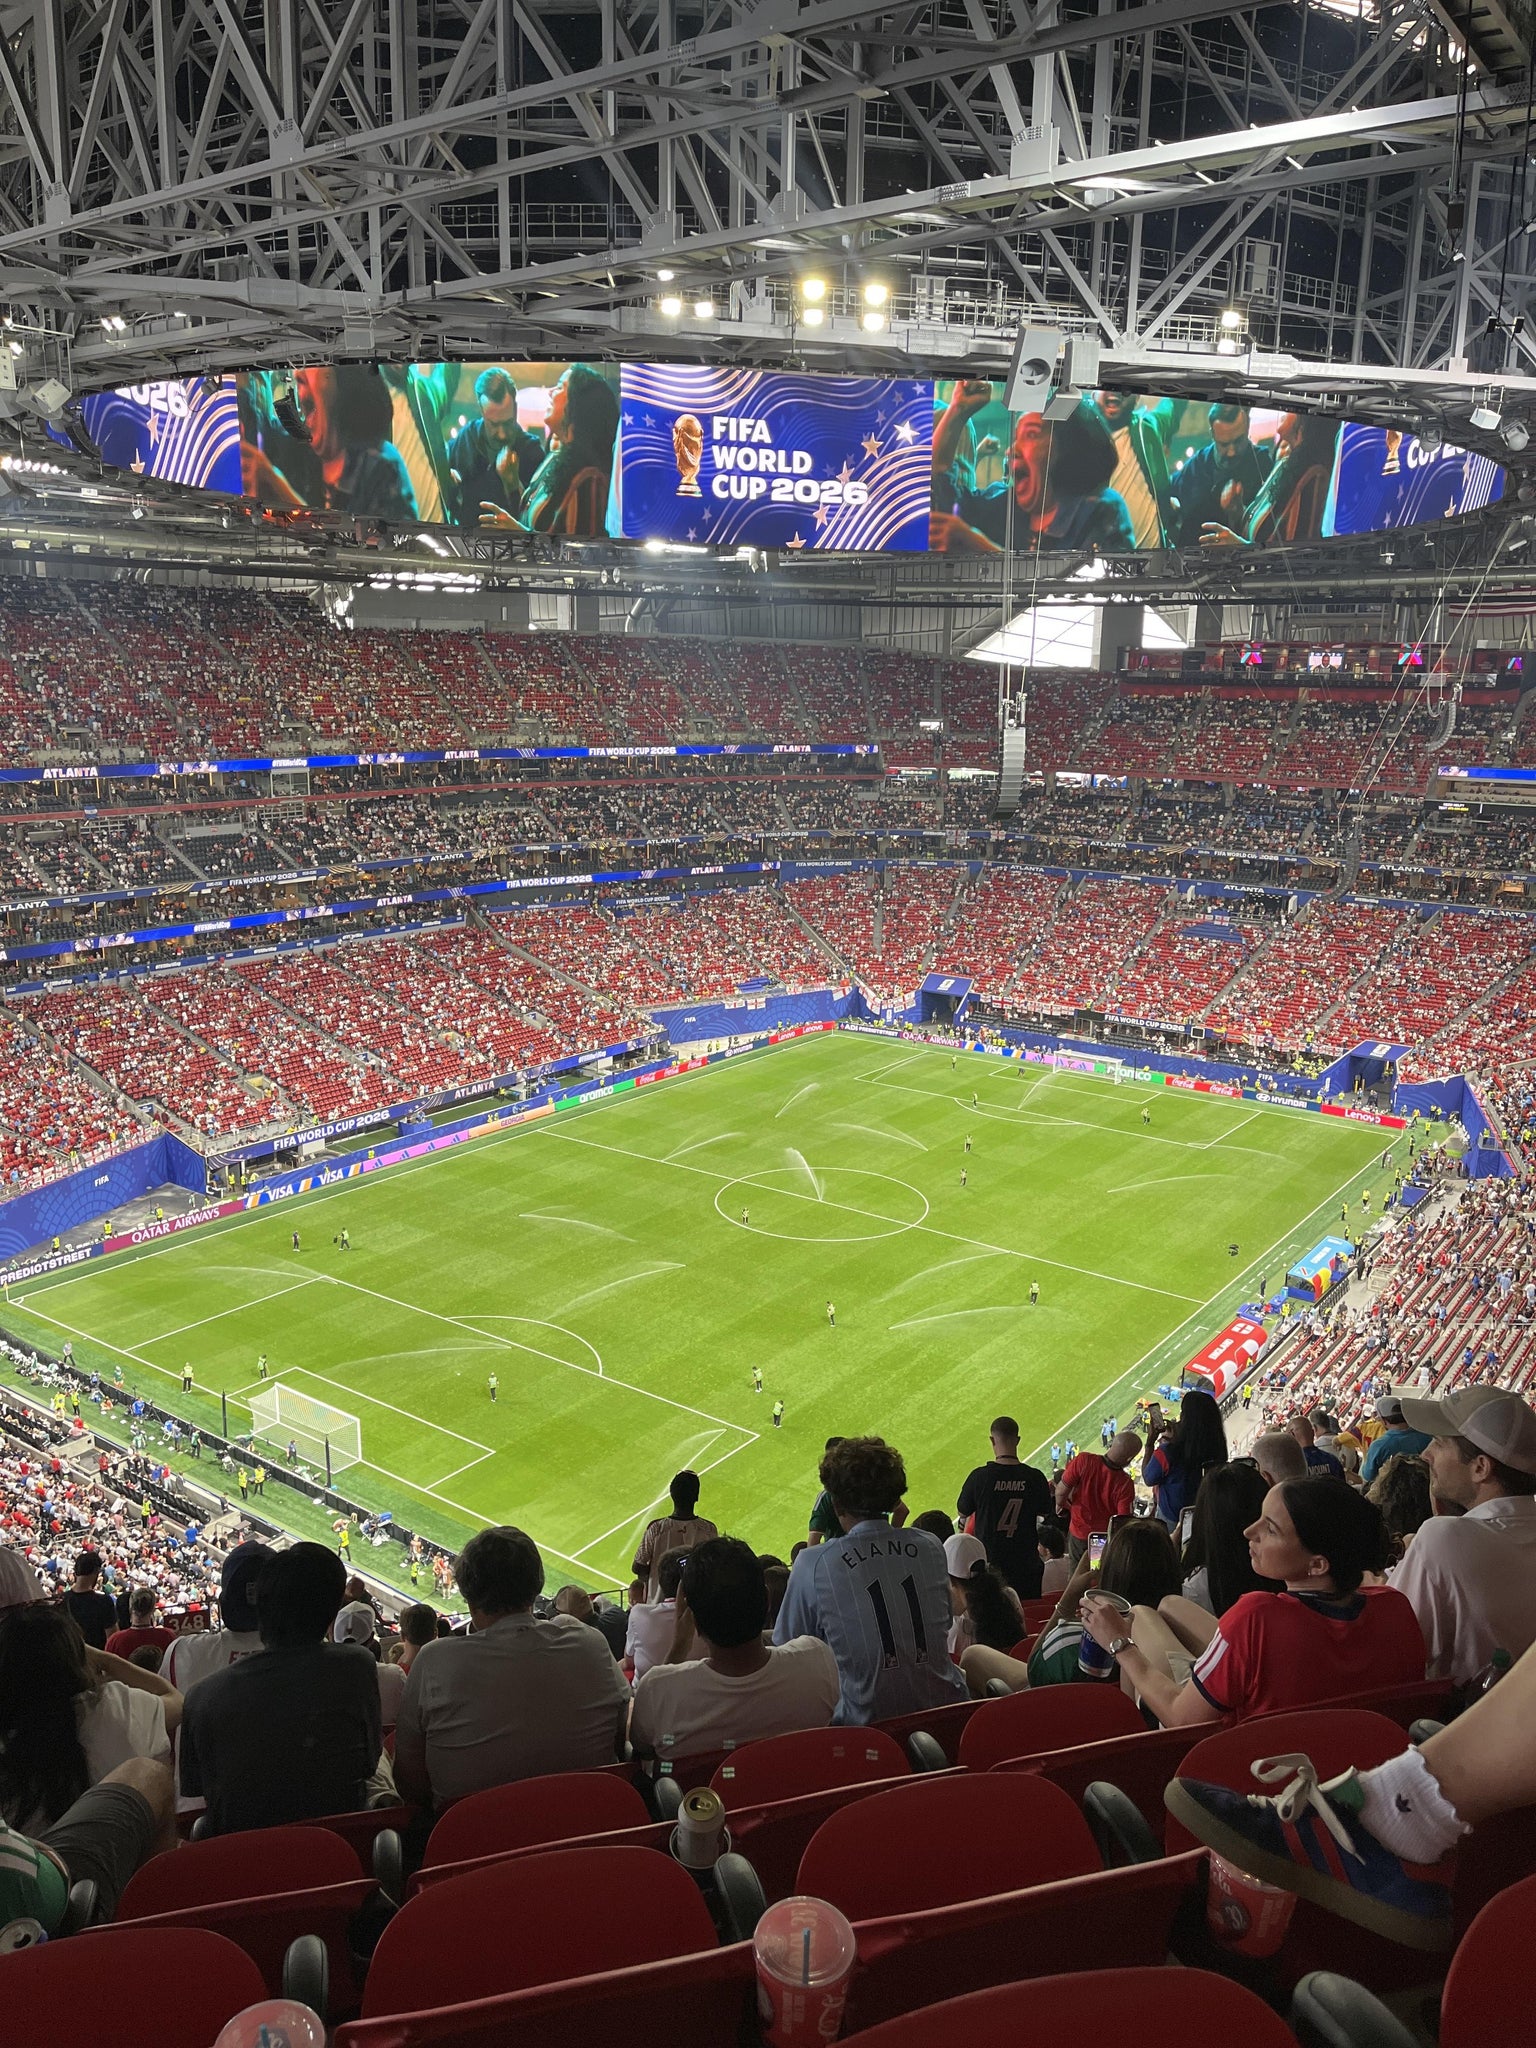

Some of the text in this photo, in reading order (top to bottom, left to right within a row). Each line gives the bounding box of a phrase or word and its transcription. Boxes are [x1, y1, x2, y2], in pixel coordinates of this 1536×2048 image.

[115, 381, 188, 417] 026
[712, 416, 771, 443] FIFA
[712, 445, 812, 474] WORLD
[712, 475, 868, 504] CUP 2026
[445, 750, 479, 759] ATLANTA
[589, 746, 676, 756] FIFA WORLD CUP 2026
[773, 744, 811, 753] ATLANTA
[43, 767, 98, 778] ATLANTA
[1090, 841, 1127, 849] ATLANTA
[430, 853, 464, 862] ATLANTA
[690, 865, 723, 875] ATLANTA
[1010, 864, 1044, 873] ATLANTA
[1379, 864, 1425, 873] ATLANTA
[229, 878, 242, 886] FIFA
[243, 876, 265, 885] WORLD
[265, 874, 277, 882] CUP
[277, 872, 298, 881] 2026
[507, 875, 592, 889] FIFA WORLD CUP 2026
[1223, 884, 1264, 893] ATLANTA
[0, 900, 49, 912] TLANTA
[376, 895, 413, 907] ATLANTA
[1478, 908, 1527, 919] ATLANTA
[1104, 1014, 1185, 1032] FIFA WORLD CUP 2026
[778, 1024, 823, 1041] Lenovo Lenovo
[929, 1037, 960, 1047] AIRWAYS
[983, 1044, 1003, 1055] VISA
[1258, 1073, 1273, 1081] FIFA
[454, 1081, 495, 1099] ATLANTA
[579, 1086, 614, 1104] aramco
[1271, 1096, 1307, 1109] HYUNDAI
[1345, 1109, 1381, 1124] Lenovo
[273, 1109, 390, 1151] FIFA WORLD CUP 2026
[94, 1175, 110, 1187] FIFA
[267, 1168, 344, 1201] VISA VISA
[131, 1207, 220, 1243] QATAR AIRWAYS
[0, 1248, 92, 1285] PREDICTSTREET
[994, 1480, 1026, 1491] ADAMS
[997, 1499, 1024, 1538] 4
[841, 1540, 918, 1569] ELANO
[168, 1614, 205, 1632] 348
[865, 1574, 929, 1670] 11
